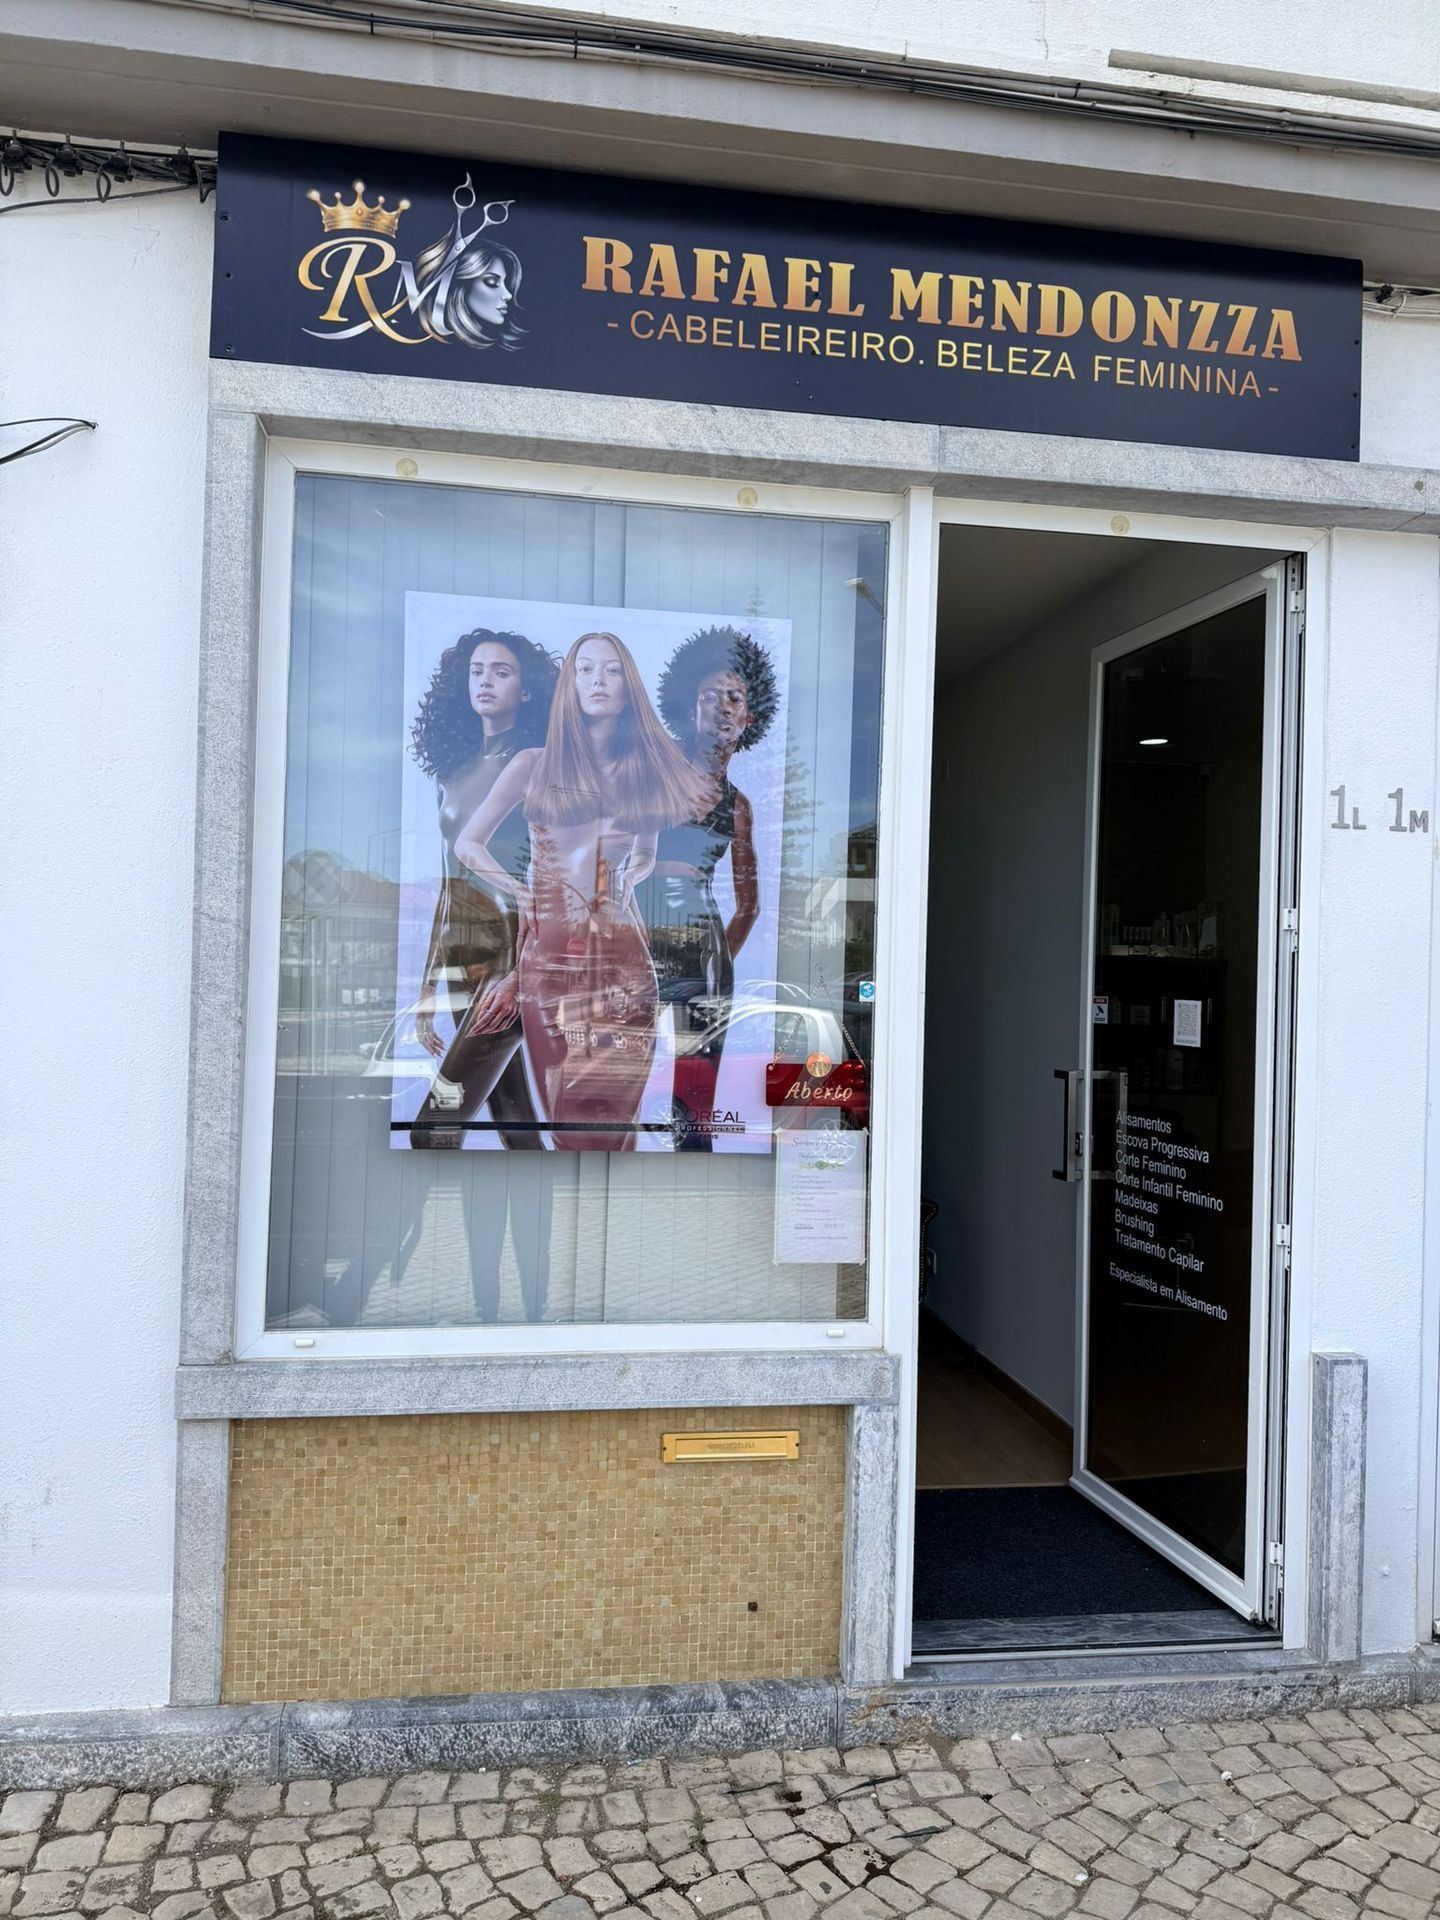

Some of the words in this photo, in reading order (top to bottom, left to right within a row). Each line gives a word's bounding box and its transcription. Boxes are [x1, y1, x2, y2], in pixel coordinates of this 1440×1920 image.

[581, 236, 866, 317] RAFAEL
[889, 267, 1303, 362] MENDONZZA
[936, 339, 1077, 380] BELEZA
[1330, 785, 1367, 830] 1L
[1388, 787, 1429, 833] 1M
[785, 1081, 853, 1102] Aberto
[1115, 1110, 1172, 1134] Alisamentos
[1115, 1129, 1149, 1150] Escova
[1151, 1136, 1209, 1163] Progressiva
[1115, 1149, 1140, 1168] Corte
[1142, 1155, 1187, 1180] Feminino
[1115, 1169, 1140, 1188] Corte
[1142, 1176, 1173, 1198] Infantil
[1175, 1184, 1224, 1211] Feminino
[1115, 1188, 1159, 1214] Madeixas
[1115, 1208, 1155, 1238] Brushing
[1114, 1227, 1166, 1260] Tratamento
[1168, 1247, 1205, 1273] Capilar
[1109, 1262, 1158, 1293] Especialista
[1160, 1285, 1174, 1300] em
[1175, 1287, 1228, 1321] Alisamento
